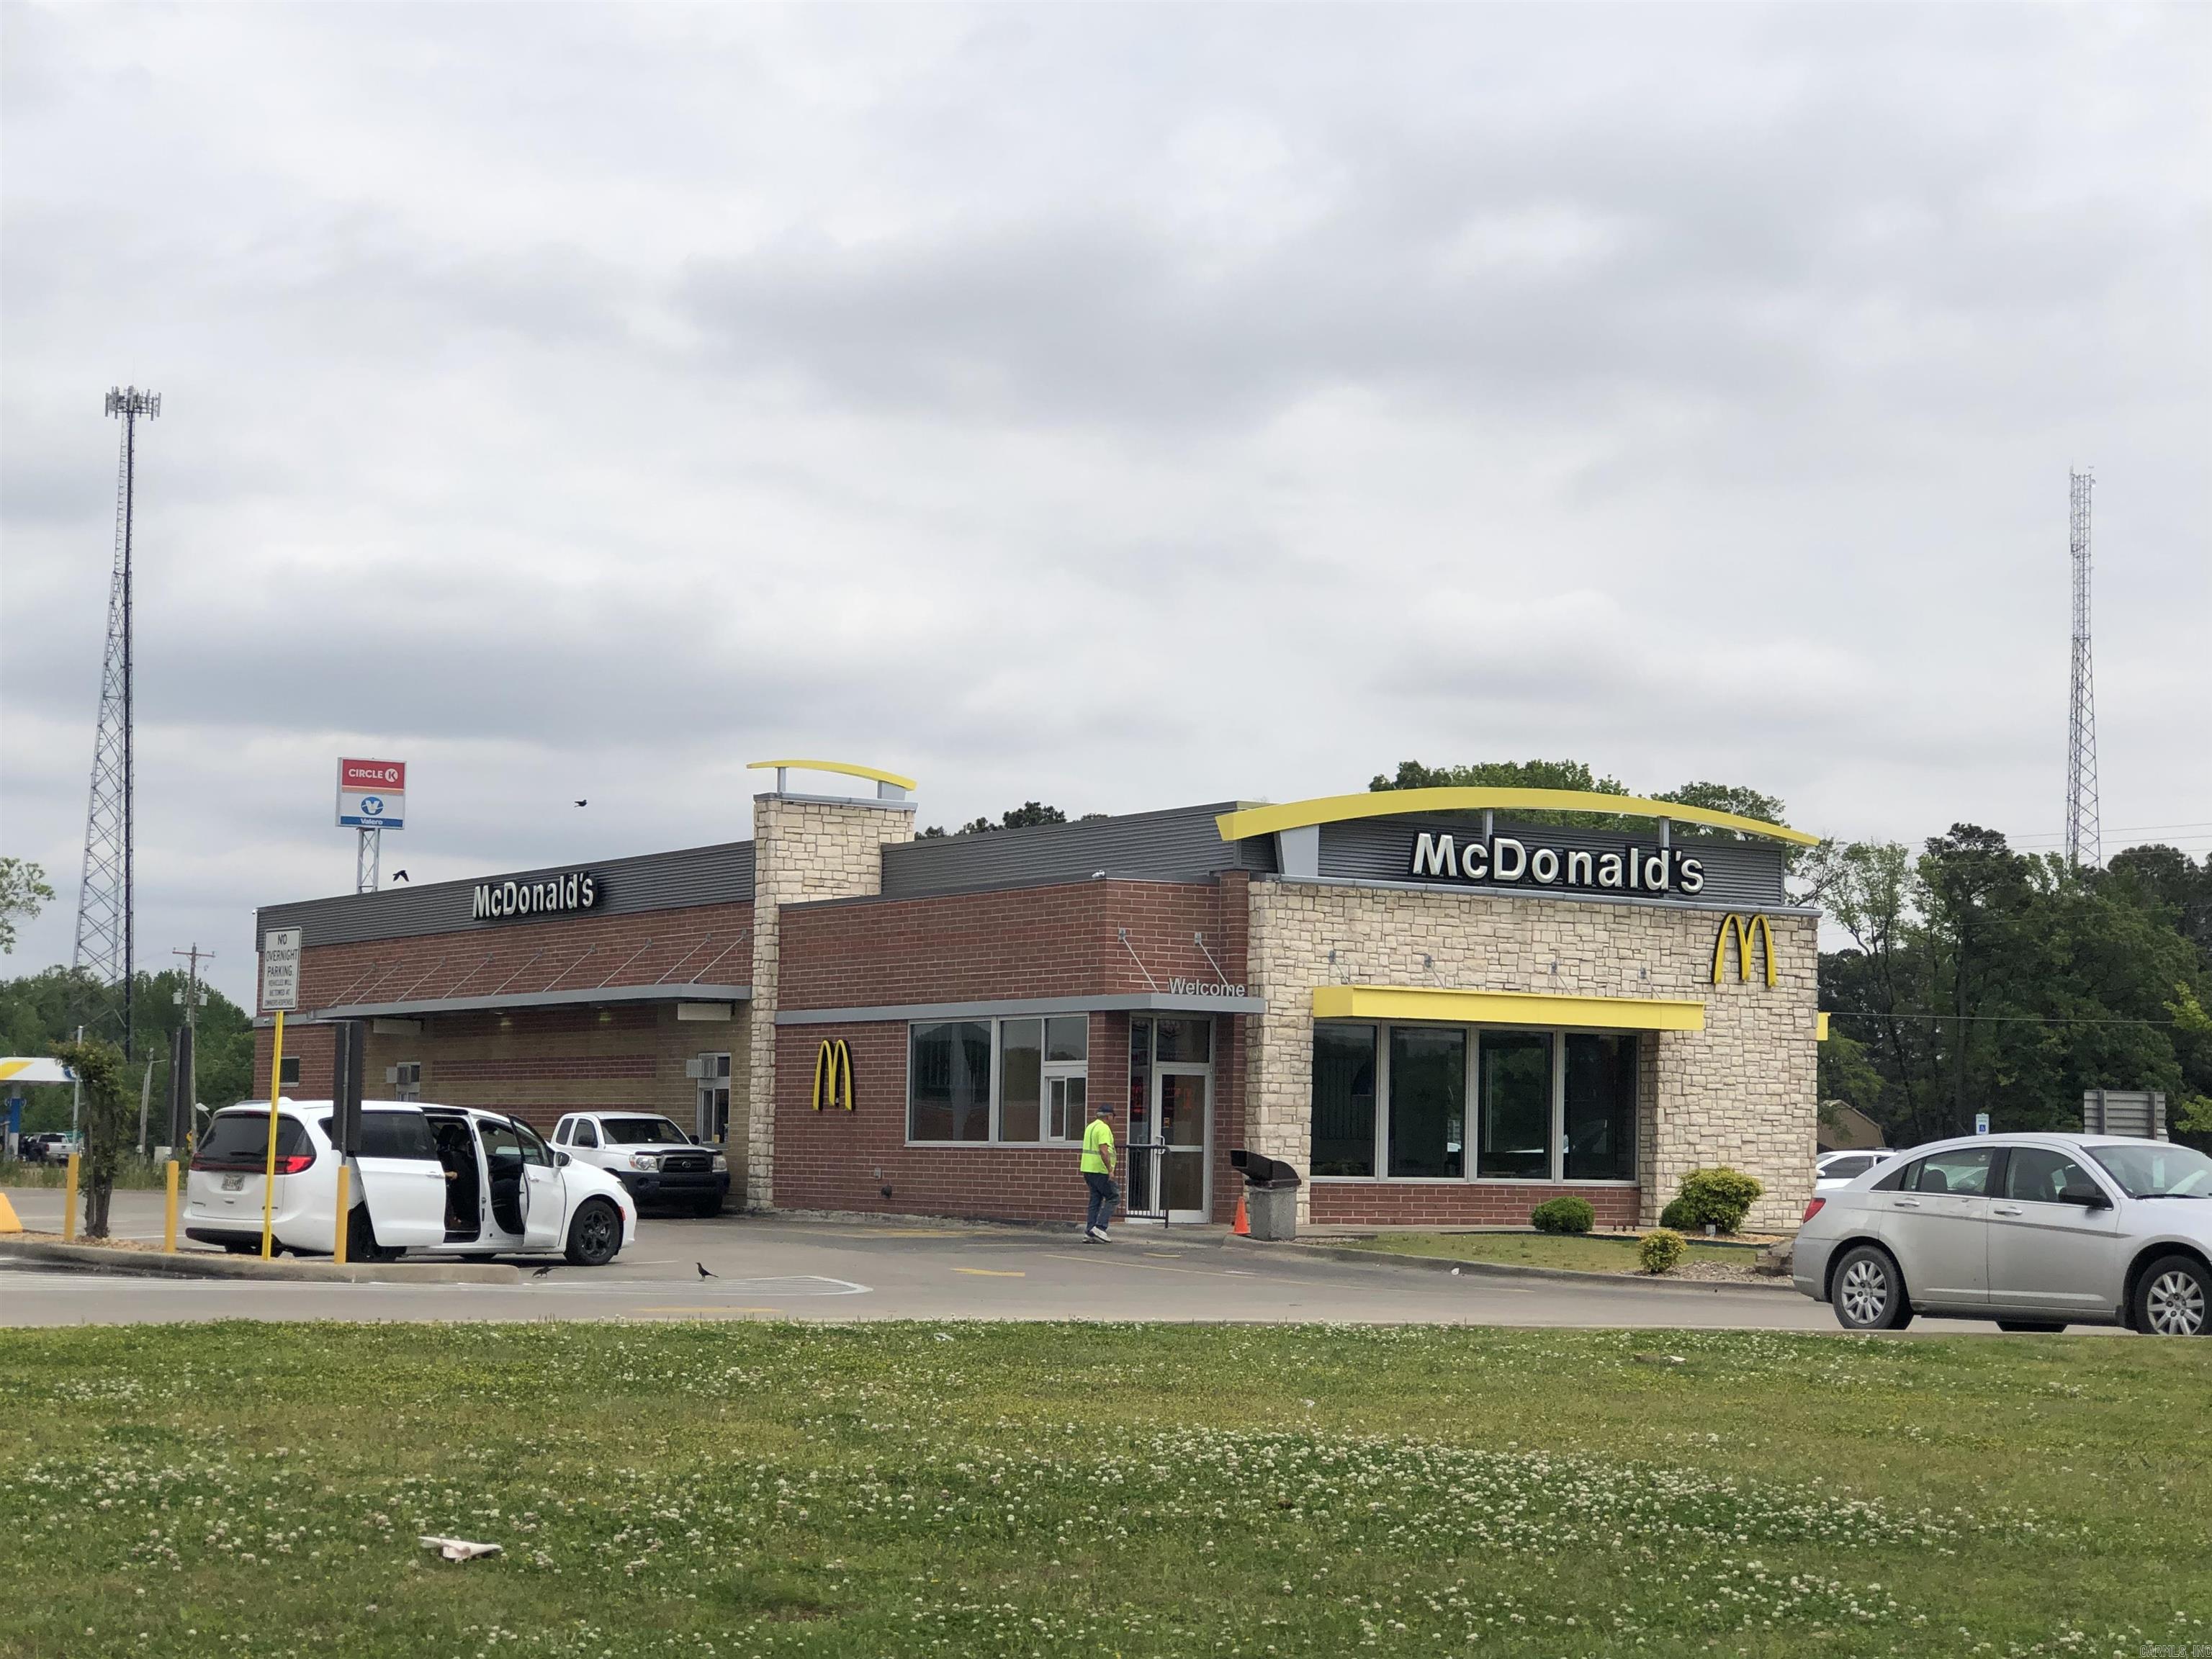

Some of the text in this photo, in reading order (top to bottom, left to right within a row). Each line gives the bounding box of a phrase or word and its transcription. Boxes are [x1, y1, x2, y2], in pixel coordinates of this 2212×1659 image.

[349, 768, 397, 781] CIRCLE K
[1413, 832, 1704, 894] McDonald's
[472, 873, 593, 918] McDonald's
[277, 933, 287, 945] NO
[266, 949, 298, 962] OVERNIGHT
[267, 965, 292, 977] PARKING
[1169, 977, 1245, 997] Welcome
